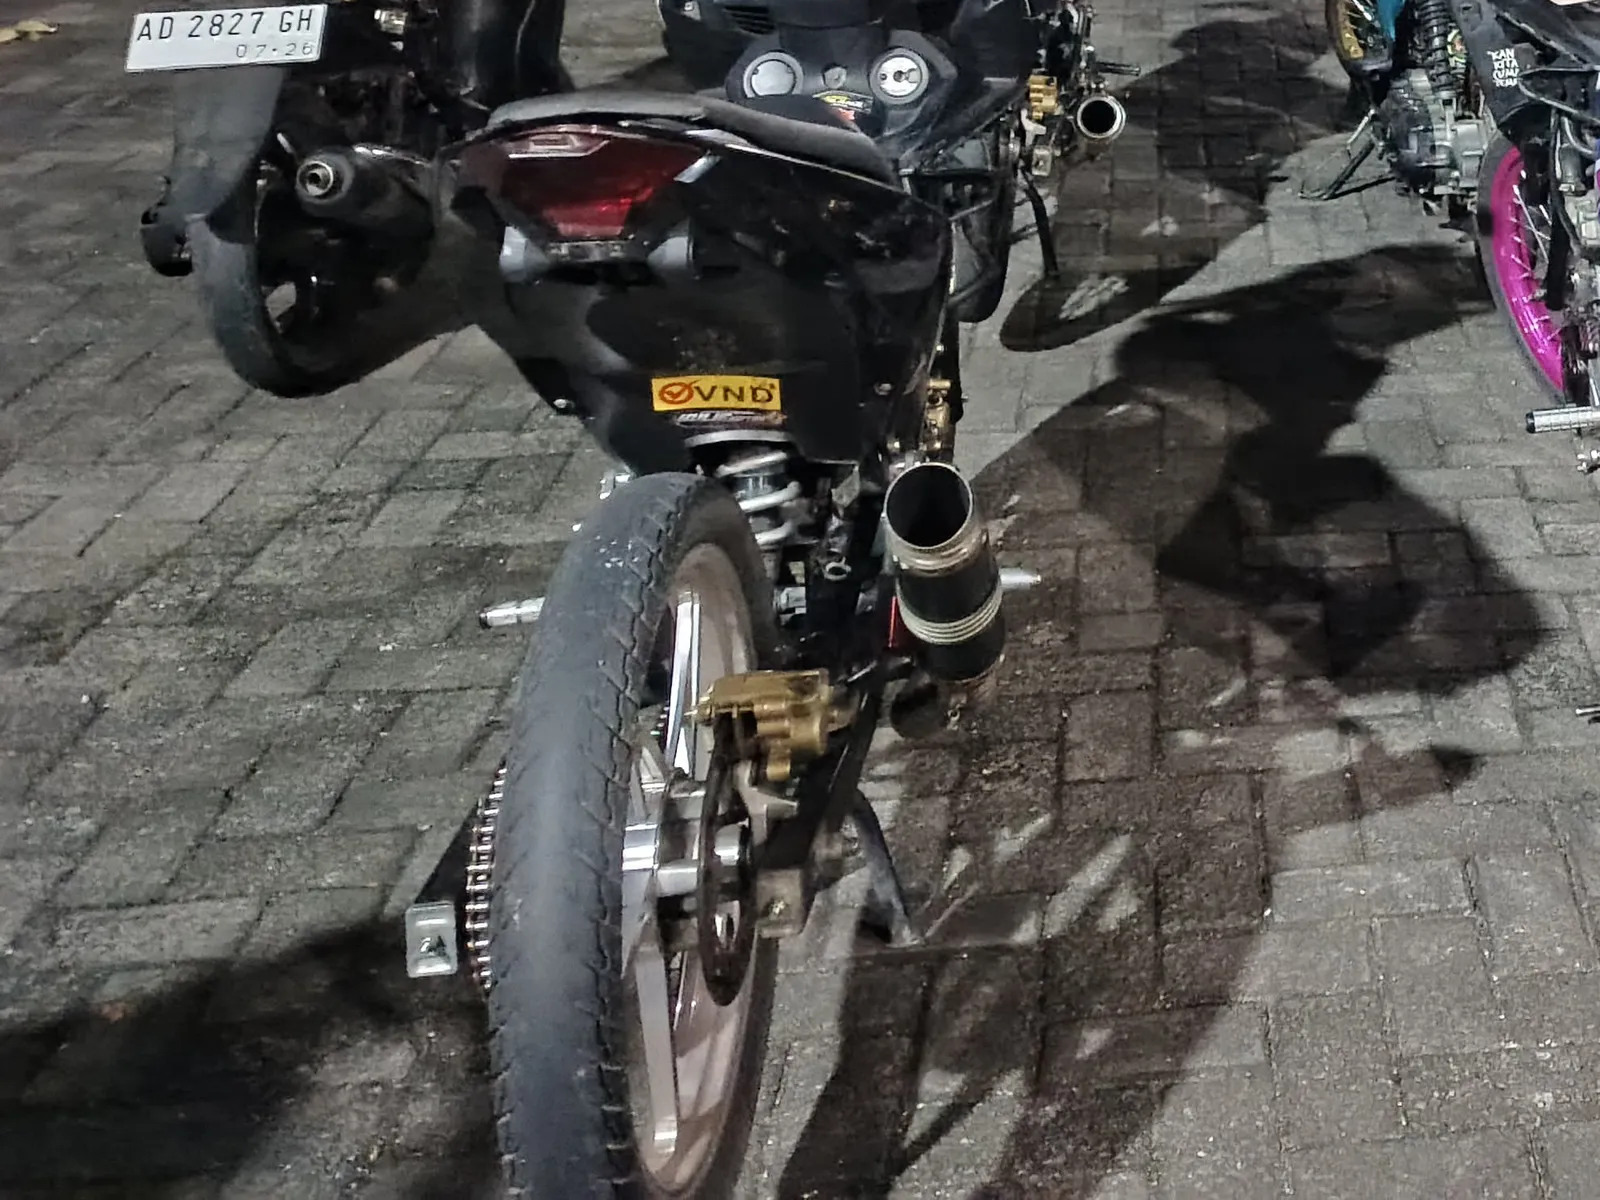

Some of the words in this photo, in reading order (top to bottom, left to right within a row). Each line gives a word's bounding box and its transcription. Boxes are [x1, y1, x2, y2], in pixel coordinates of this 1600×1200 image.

[137, 16, 174, 41] AD
[188, 12, 264, 38] 2827
[279, 9, 313, 33] GH
